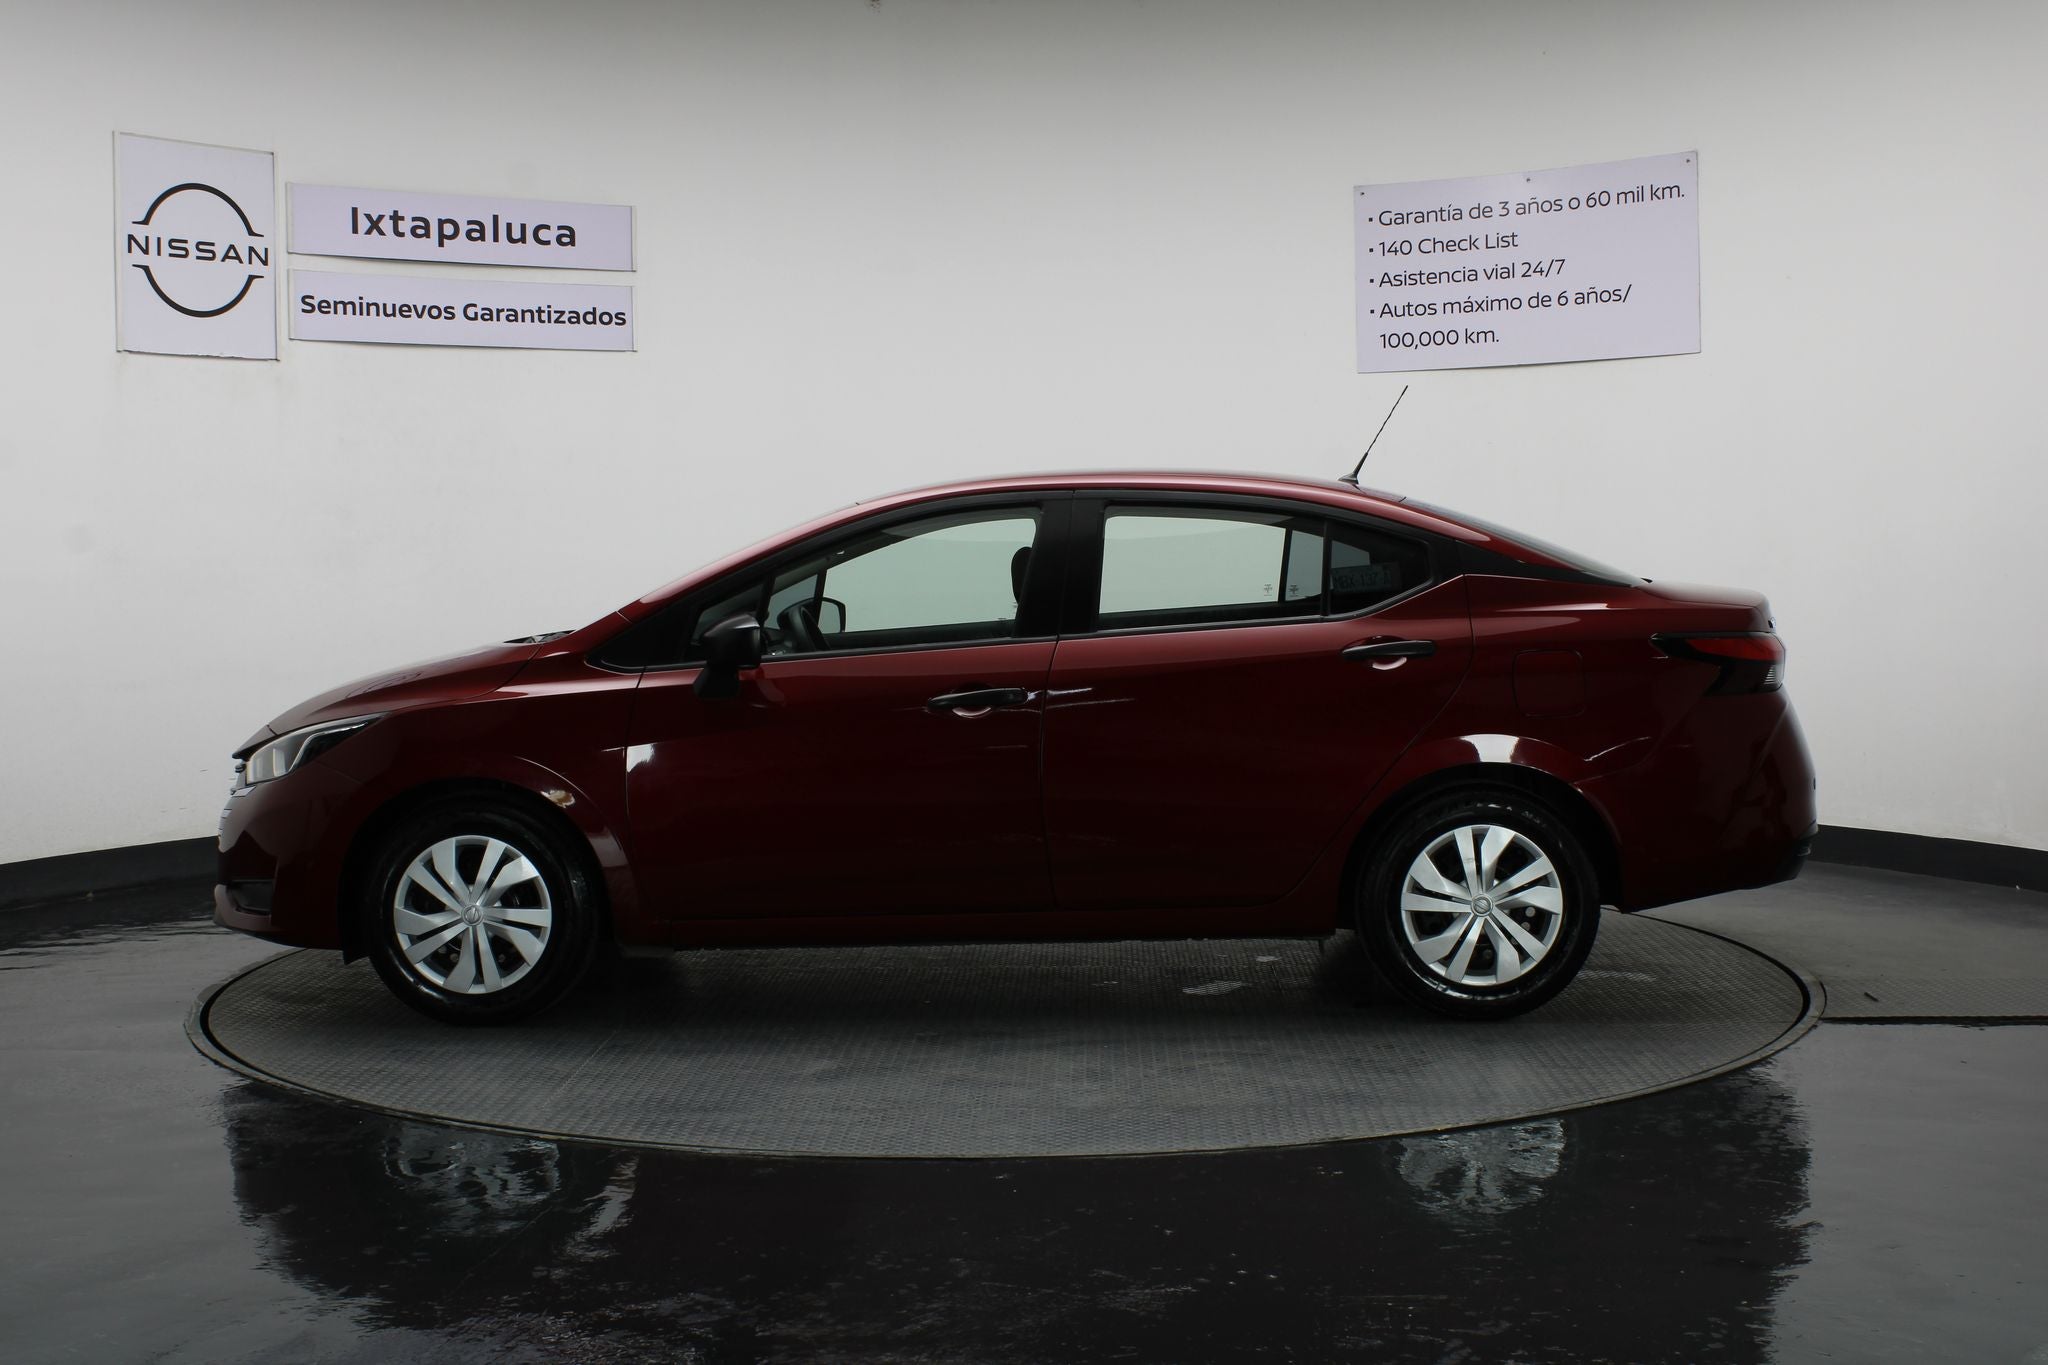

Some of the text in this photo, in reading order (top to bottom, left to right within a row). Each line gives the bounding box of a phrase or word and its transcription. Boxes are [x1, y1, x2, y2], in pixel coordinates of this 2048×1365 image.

[1379, 183, 1685, 226] Garantía de 3 años o 60 mil km.
[352, 207, 575, 247] Ixtapaluca
[128, 234, 268, 266] NISSAN
[1379, 232, 1518, 256] 140 Check List
[1379, 258, 1566, 287] Asistencia vial 24/7
[301, 295, 626, 326] Seminuevos Garantizados
[1380, 284, 1633, 318] Autos máximo de 6 años/
[1380, 328, 1500, 350] 100,000 km.
